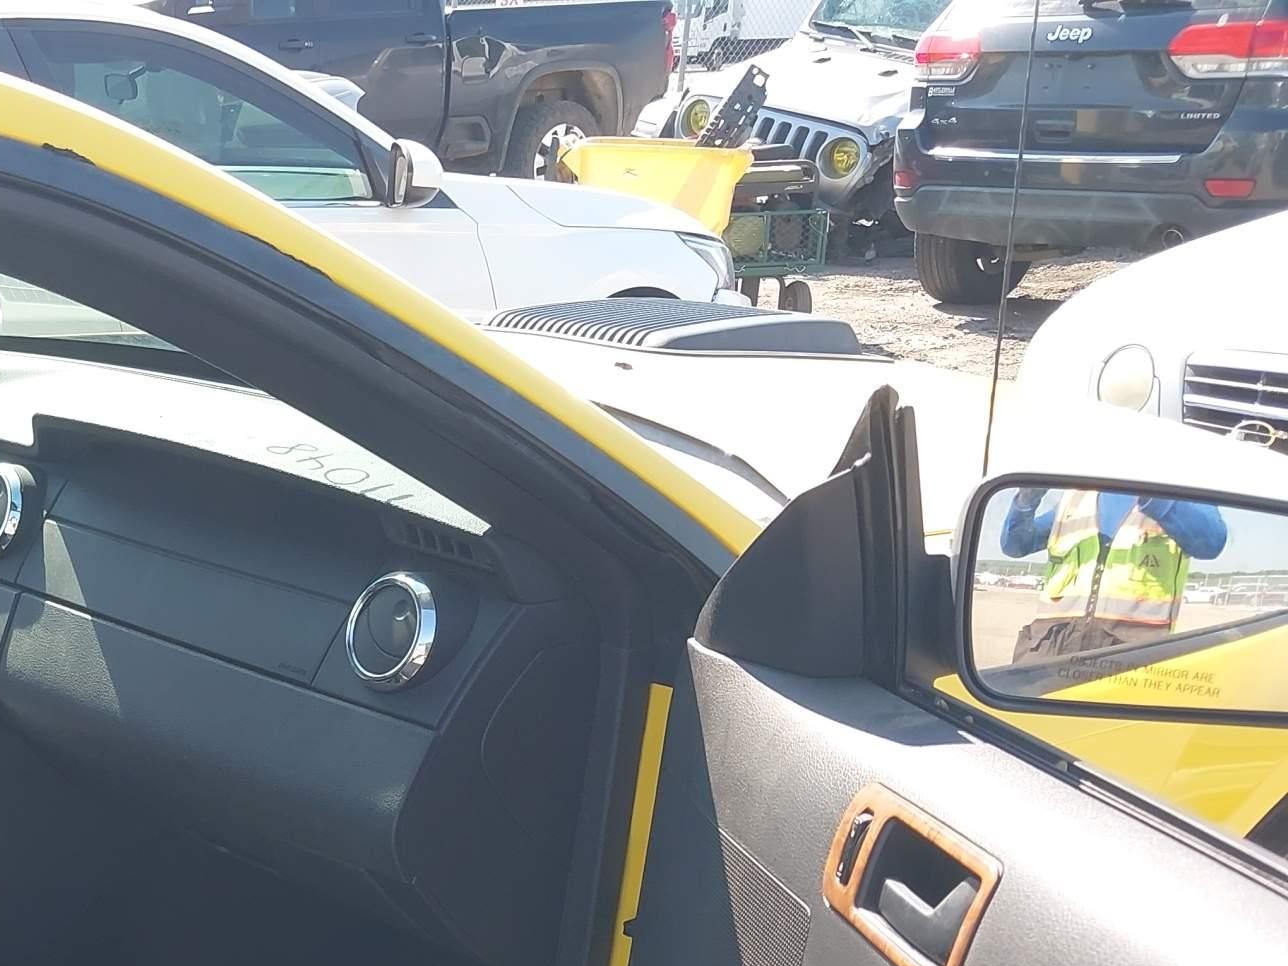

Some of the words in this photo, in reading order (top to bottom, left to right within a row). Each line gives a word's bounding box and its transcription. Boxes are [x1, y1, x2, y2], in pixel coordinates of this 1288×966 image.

[1047, 24, 1093, 44] Jeep
[1180, 112, 1221, 120] LIMITED
[1069, 655, 1123, 672] OBJECTS
[1144, 663, 1189, 681] MIRROR
[1192, 670, 1217, 684] ARE
[1057, 667, 1105, 682] CLOSER
[1106, 674, 1138, 687] THAN
[1143, 677, 1172, 691] THEY
[1175, 682, 1221, 697] APPEAR
